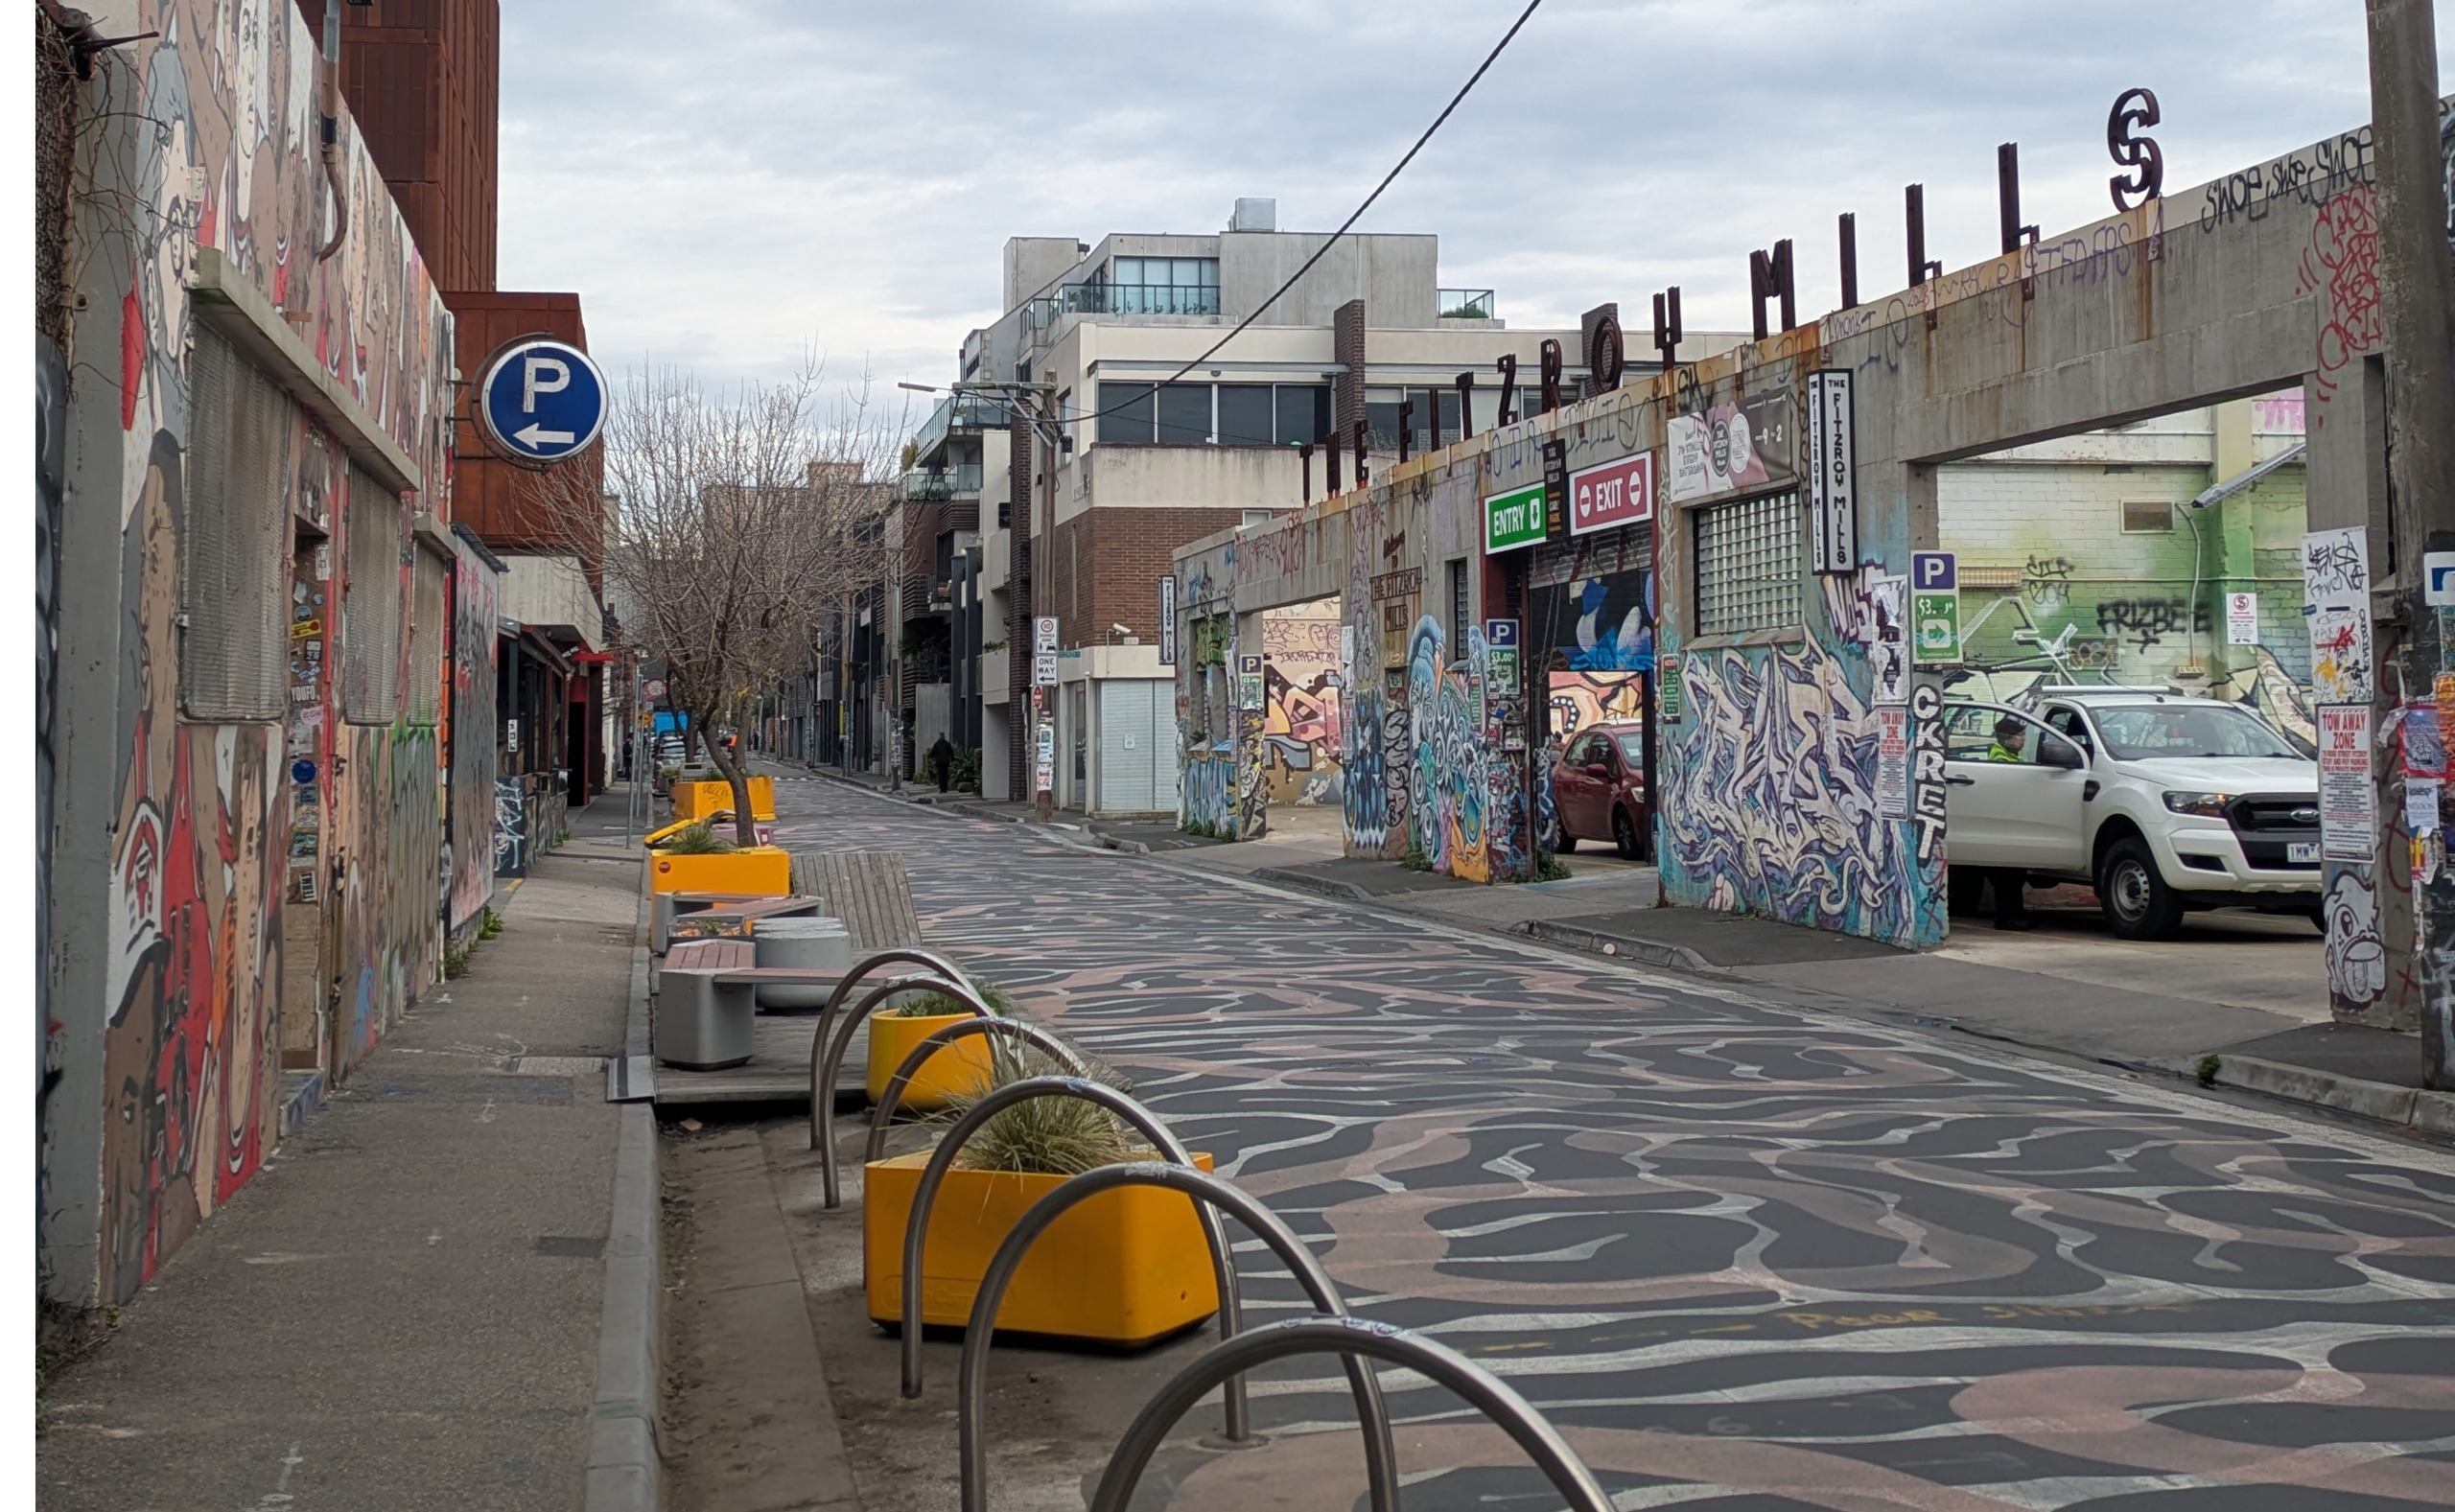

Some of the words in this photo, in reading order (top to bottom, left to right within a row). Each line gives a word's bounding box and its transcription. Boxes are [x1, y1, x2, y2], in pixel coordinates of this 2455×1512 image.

[1299, 419, 1369, 502] THE
[1399, 287, 1682, 463] FITZROY
[1749, 88, 2163, 341] MILLS
[523, 357, 570, 413] P
[1828, 380, 1846, 388] THE
[1812, 394, 1820, 487] FITZROY
[1833, 393, 1846, 487] FITZROY
[1596, 477, 1624, 513] EXIT
[1493, 503, 1526, 537] ENTRY
[1834, 496, 1846, 565] MILLS
[1369, 574, 1385, 601] THE
[1387, 566, 1421, 598] FITZROY
[1924, 558, 1945, 585] P
[1385, 604, 1408, 632] MILLS
[1496, 624, 1510, 640] P
[1247, 658, 1256, 671] P
[2323, 713, 2340, 731] TOW
[2343, 713, 2366, 731] AWAY
[2333, 732, 2355, 749] ZONE
